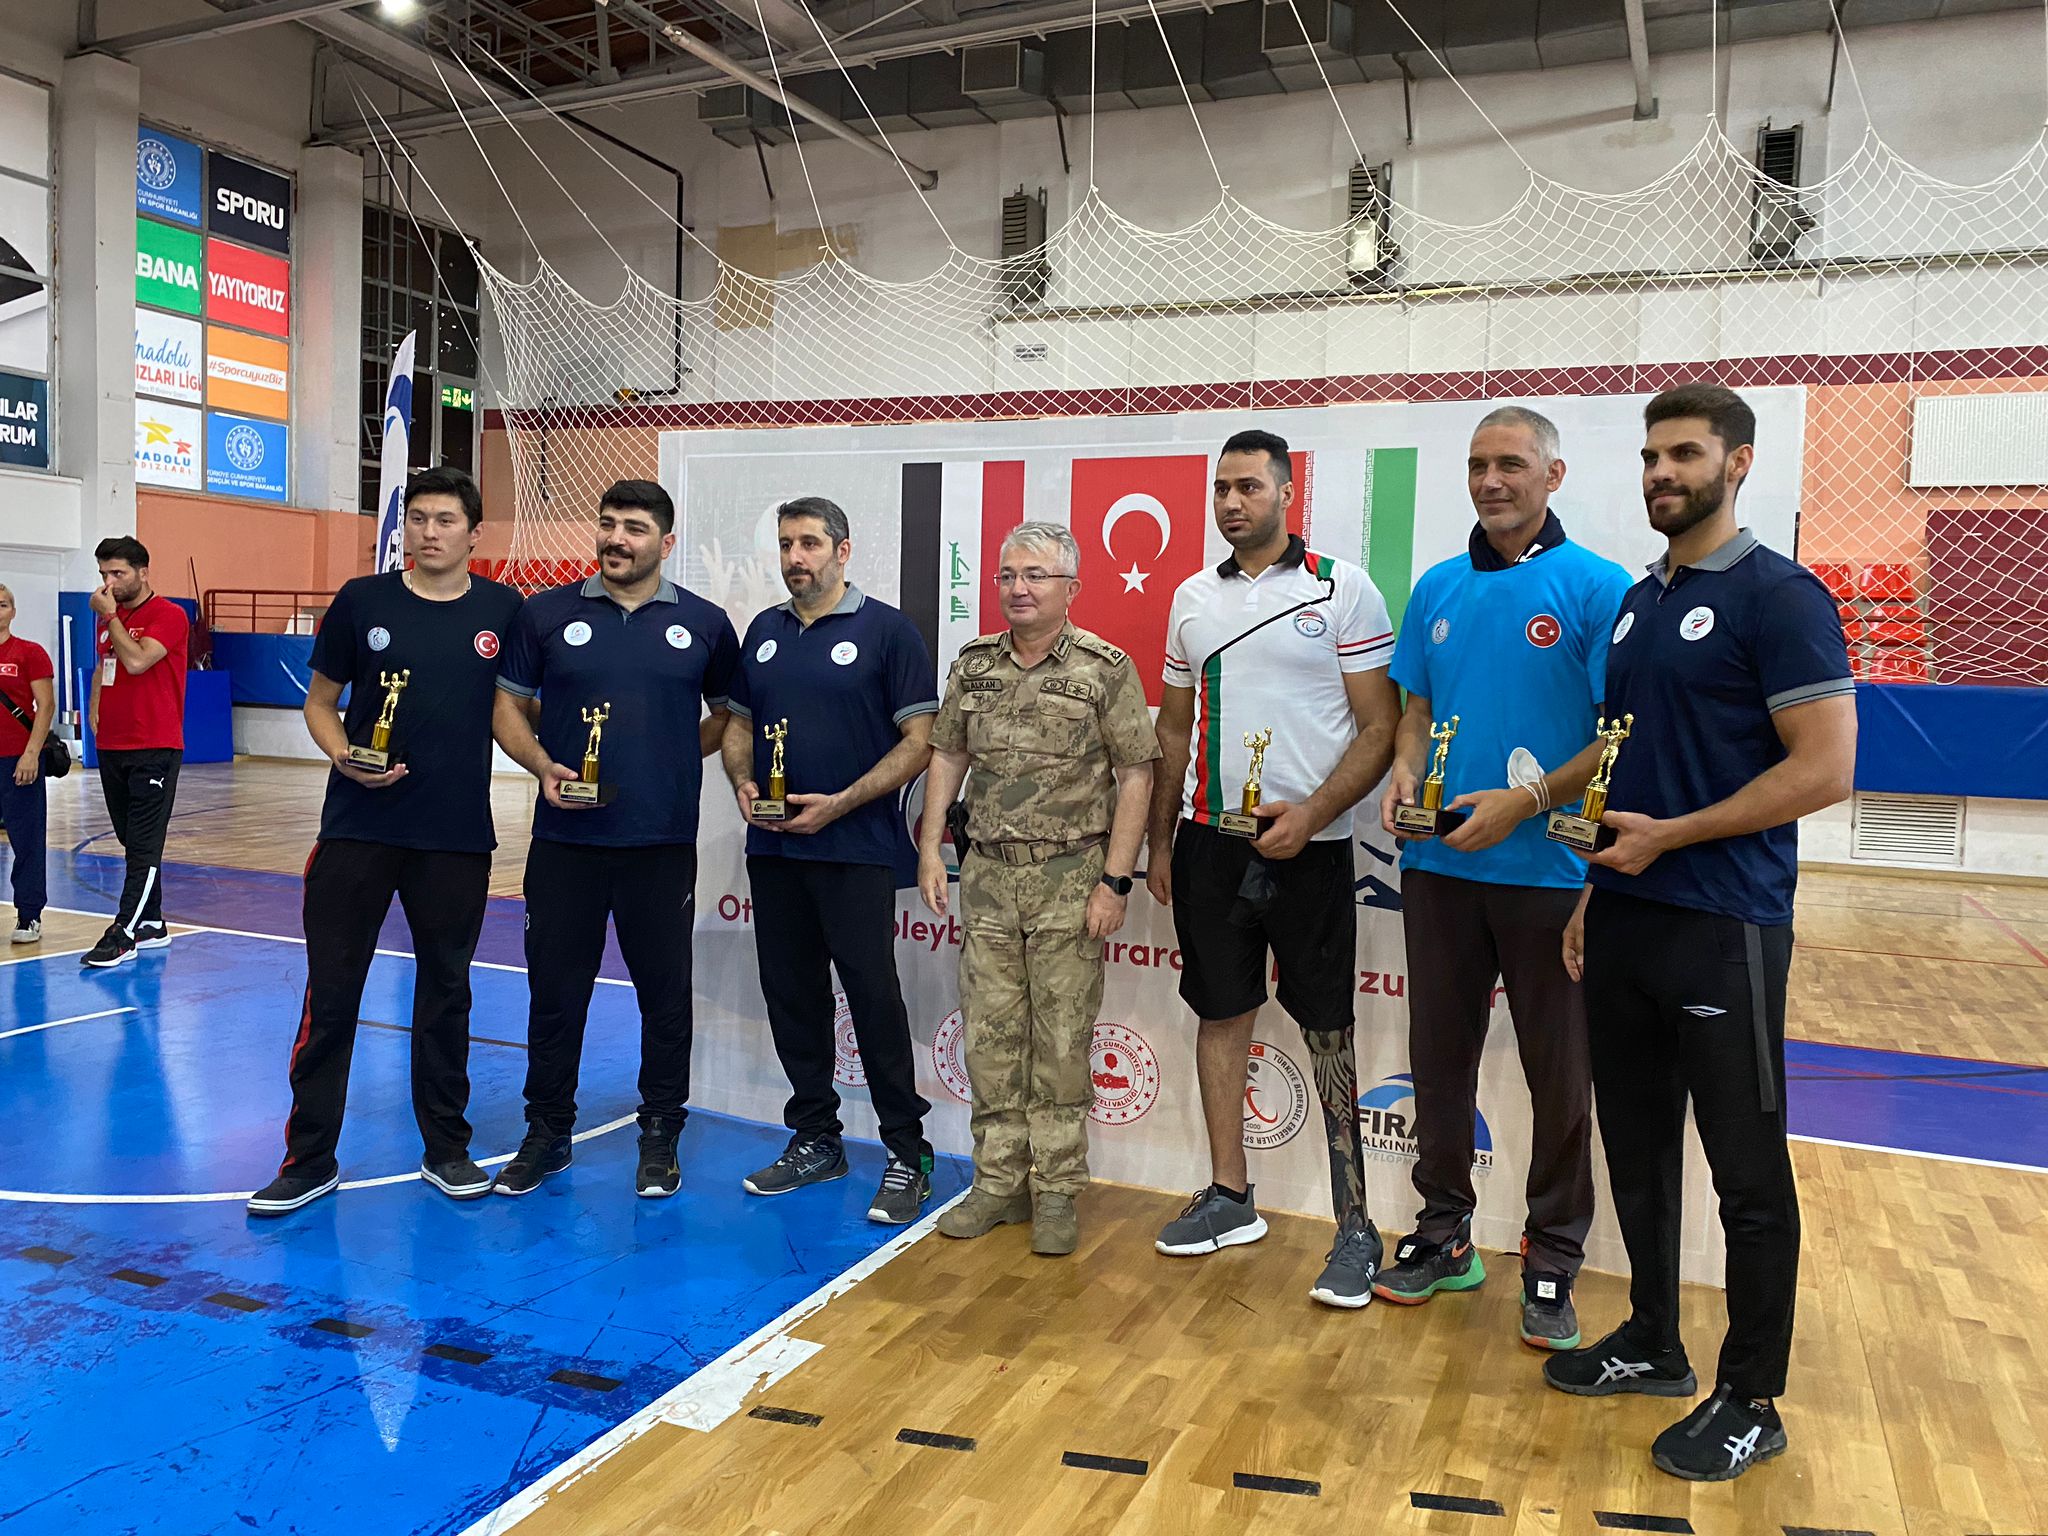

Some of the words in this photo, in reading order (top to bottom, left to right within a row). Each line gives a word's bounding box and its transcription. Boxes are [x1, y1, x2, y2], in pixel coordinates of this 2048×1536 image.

[147, 199, 165, 211] SPOR
[216, 187, 285, 230] SPORU
[135, 252, 199, 291] BANA
[208, 271, 285, 313] YAYIYORUZ
[208, 360, 285, 386] #SporcuyuzBiz
[135, 460, 191, 476] DIZLARI
[970, 681, 996, 690] ALKAN
[1103, 1041, 1143, 1077] CUMHURİYETİ
[1273, 1053, 1299, 1082] TÜRKİYE
[1293, 1083, 1304, 1122] BEDENSEL
[1256, 1122, 1297, 1146] ENGELLİLER
